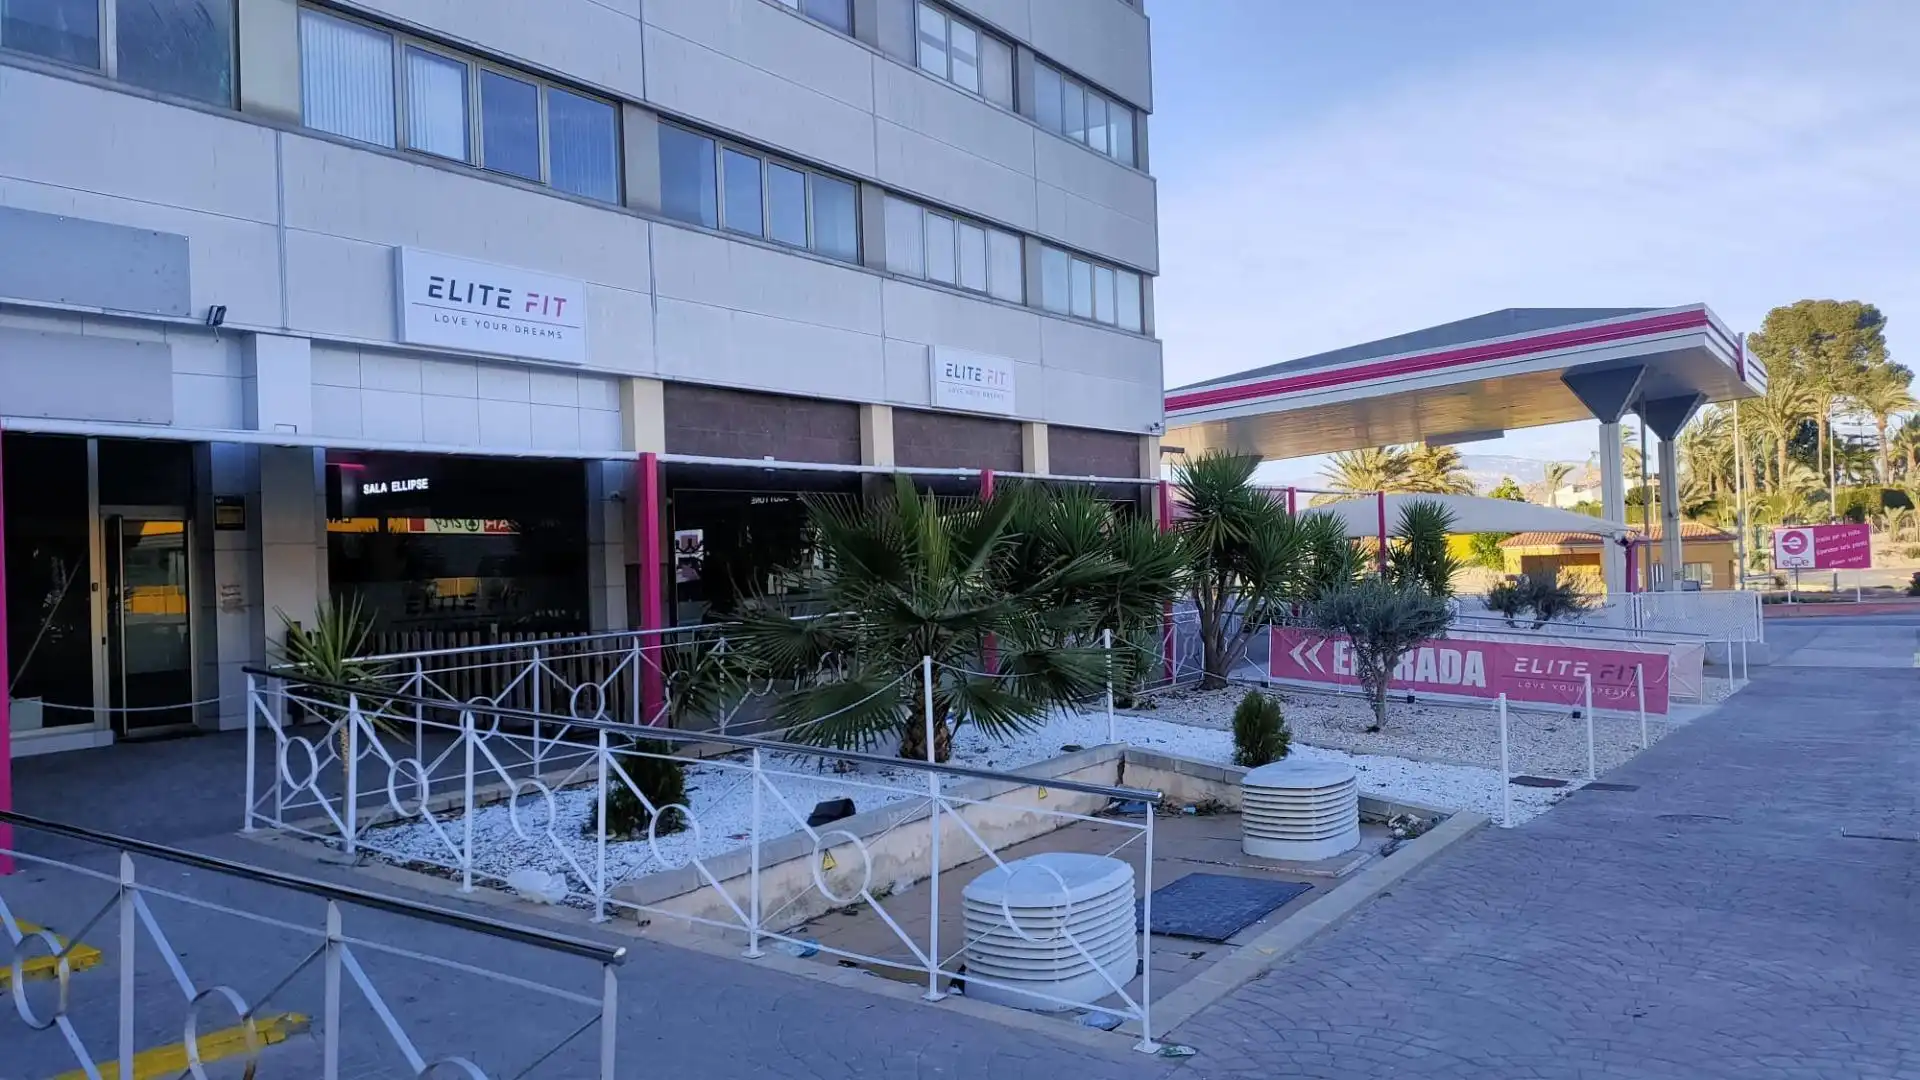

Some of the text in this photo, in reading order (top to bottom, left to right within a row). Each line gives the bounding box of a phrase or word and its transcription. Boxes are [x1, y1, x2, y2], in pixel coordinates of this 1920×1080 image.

[428, 275, 567, 318] ELITE FIT
[434, 313, 563, 340] LOVE YOUR DREAMS
[945, 362, 1007, 385] ELITE FIT
[363, 478, 429, 495] SALA ELLIPSE
[1333, 640, 1485, 688] ERADA
[1514, 657, 1638, 681] ELITE FIT
[1518, 681, 1545, 690] LOVE
